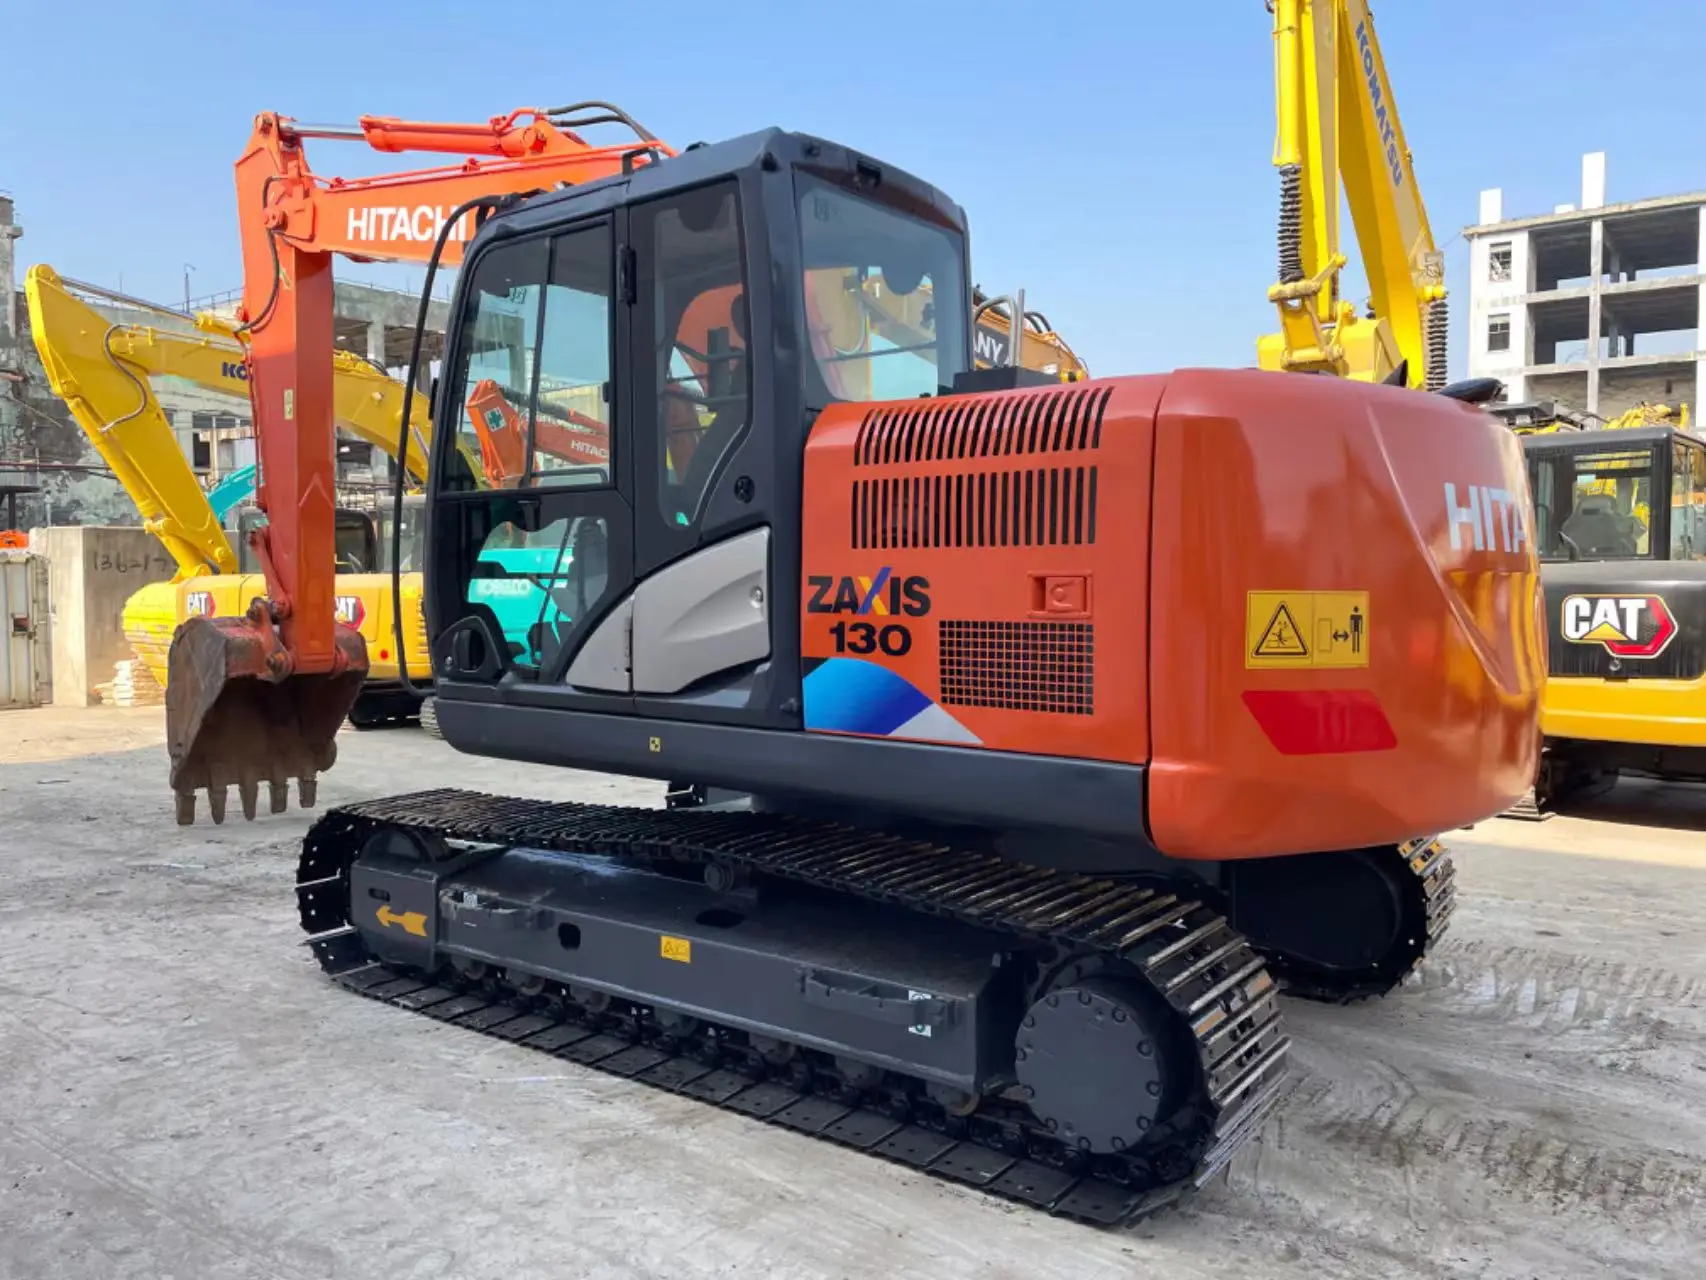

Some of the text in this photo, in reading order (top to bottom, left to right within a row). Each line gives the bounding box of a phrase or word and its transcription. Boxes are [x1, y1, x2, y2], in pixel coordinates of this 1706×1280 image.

[1356, 20, 1402, 186] KOMATSU
[347, 205, 467, 241] HITACHI
[187, 592, 208, 616] CAT
[807, 566, 931, 617] ZAXIS
[1565, 597, 1646, 640] CAT
[829, 621, 912, 656] 130
